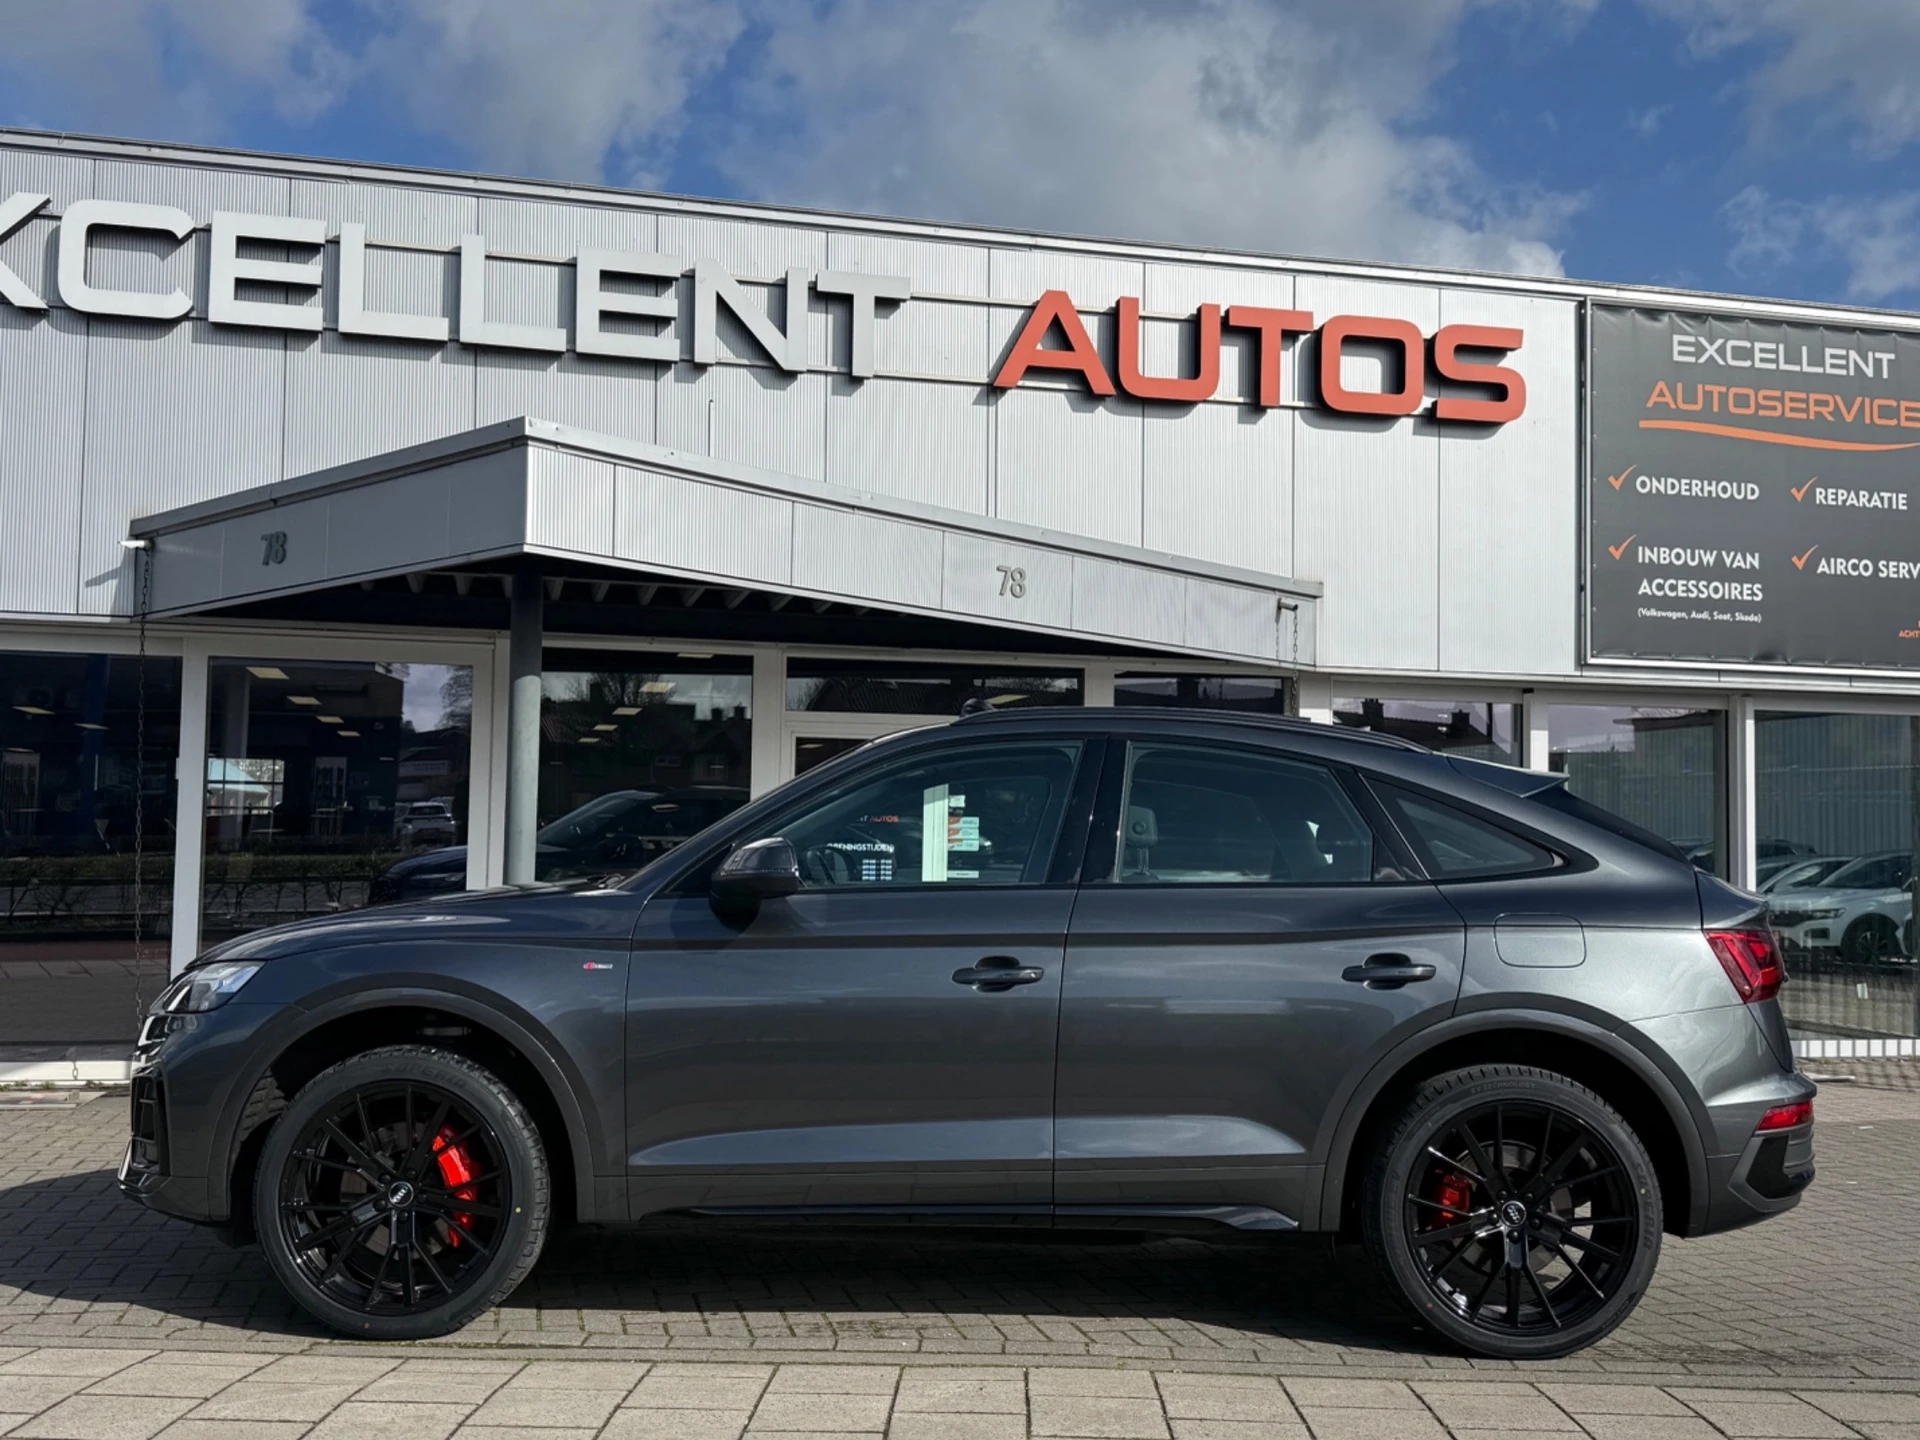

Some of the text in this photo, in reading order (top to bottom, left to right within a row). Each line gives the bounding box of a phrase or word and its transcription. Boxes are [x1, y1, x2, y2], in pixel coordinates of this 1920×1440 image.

[993, 290, 1527, 423] AUTOS
[1672, 334, 1895, 379] EXCELLENT
[1646, 380, 1920, 428] AUTOSERVICE
[1636, 476, 1760, 501] ONDERHOUD
[1815, 487, 1908, 511] REPARATIE
[260, 530, 287, 566] 78
[1637, 545, 1760, 570] INBOUW VAN
[1816, 557, 1920, 580] AIRCO SERV
[996, 565, 1026, 599] 78
[1637, 577, 1763, 602] ACCESSOIRES
[1637, 607, 1762, 623] (Volkswagen, Audi, Seat, Skoda)
